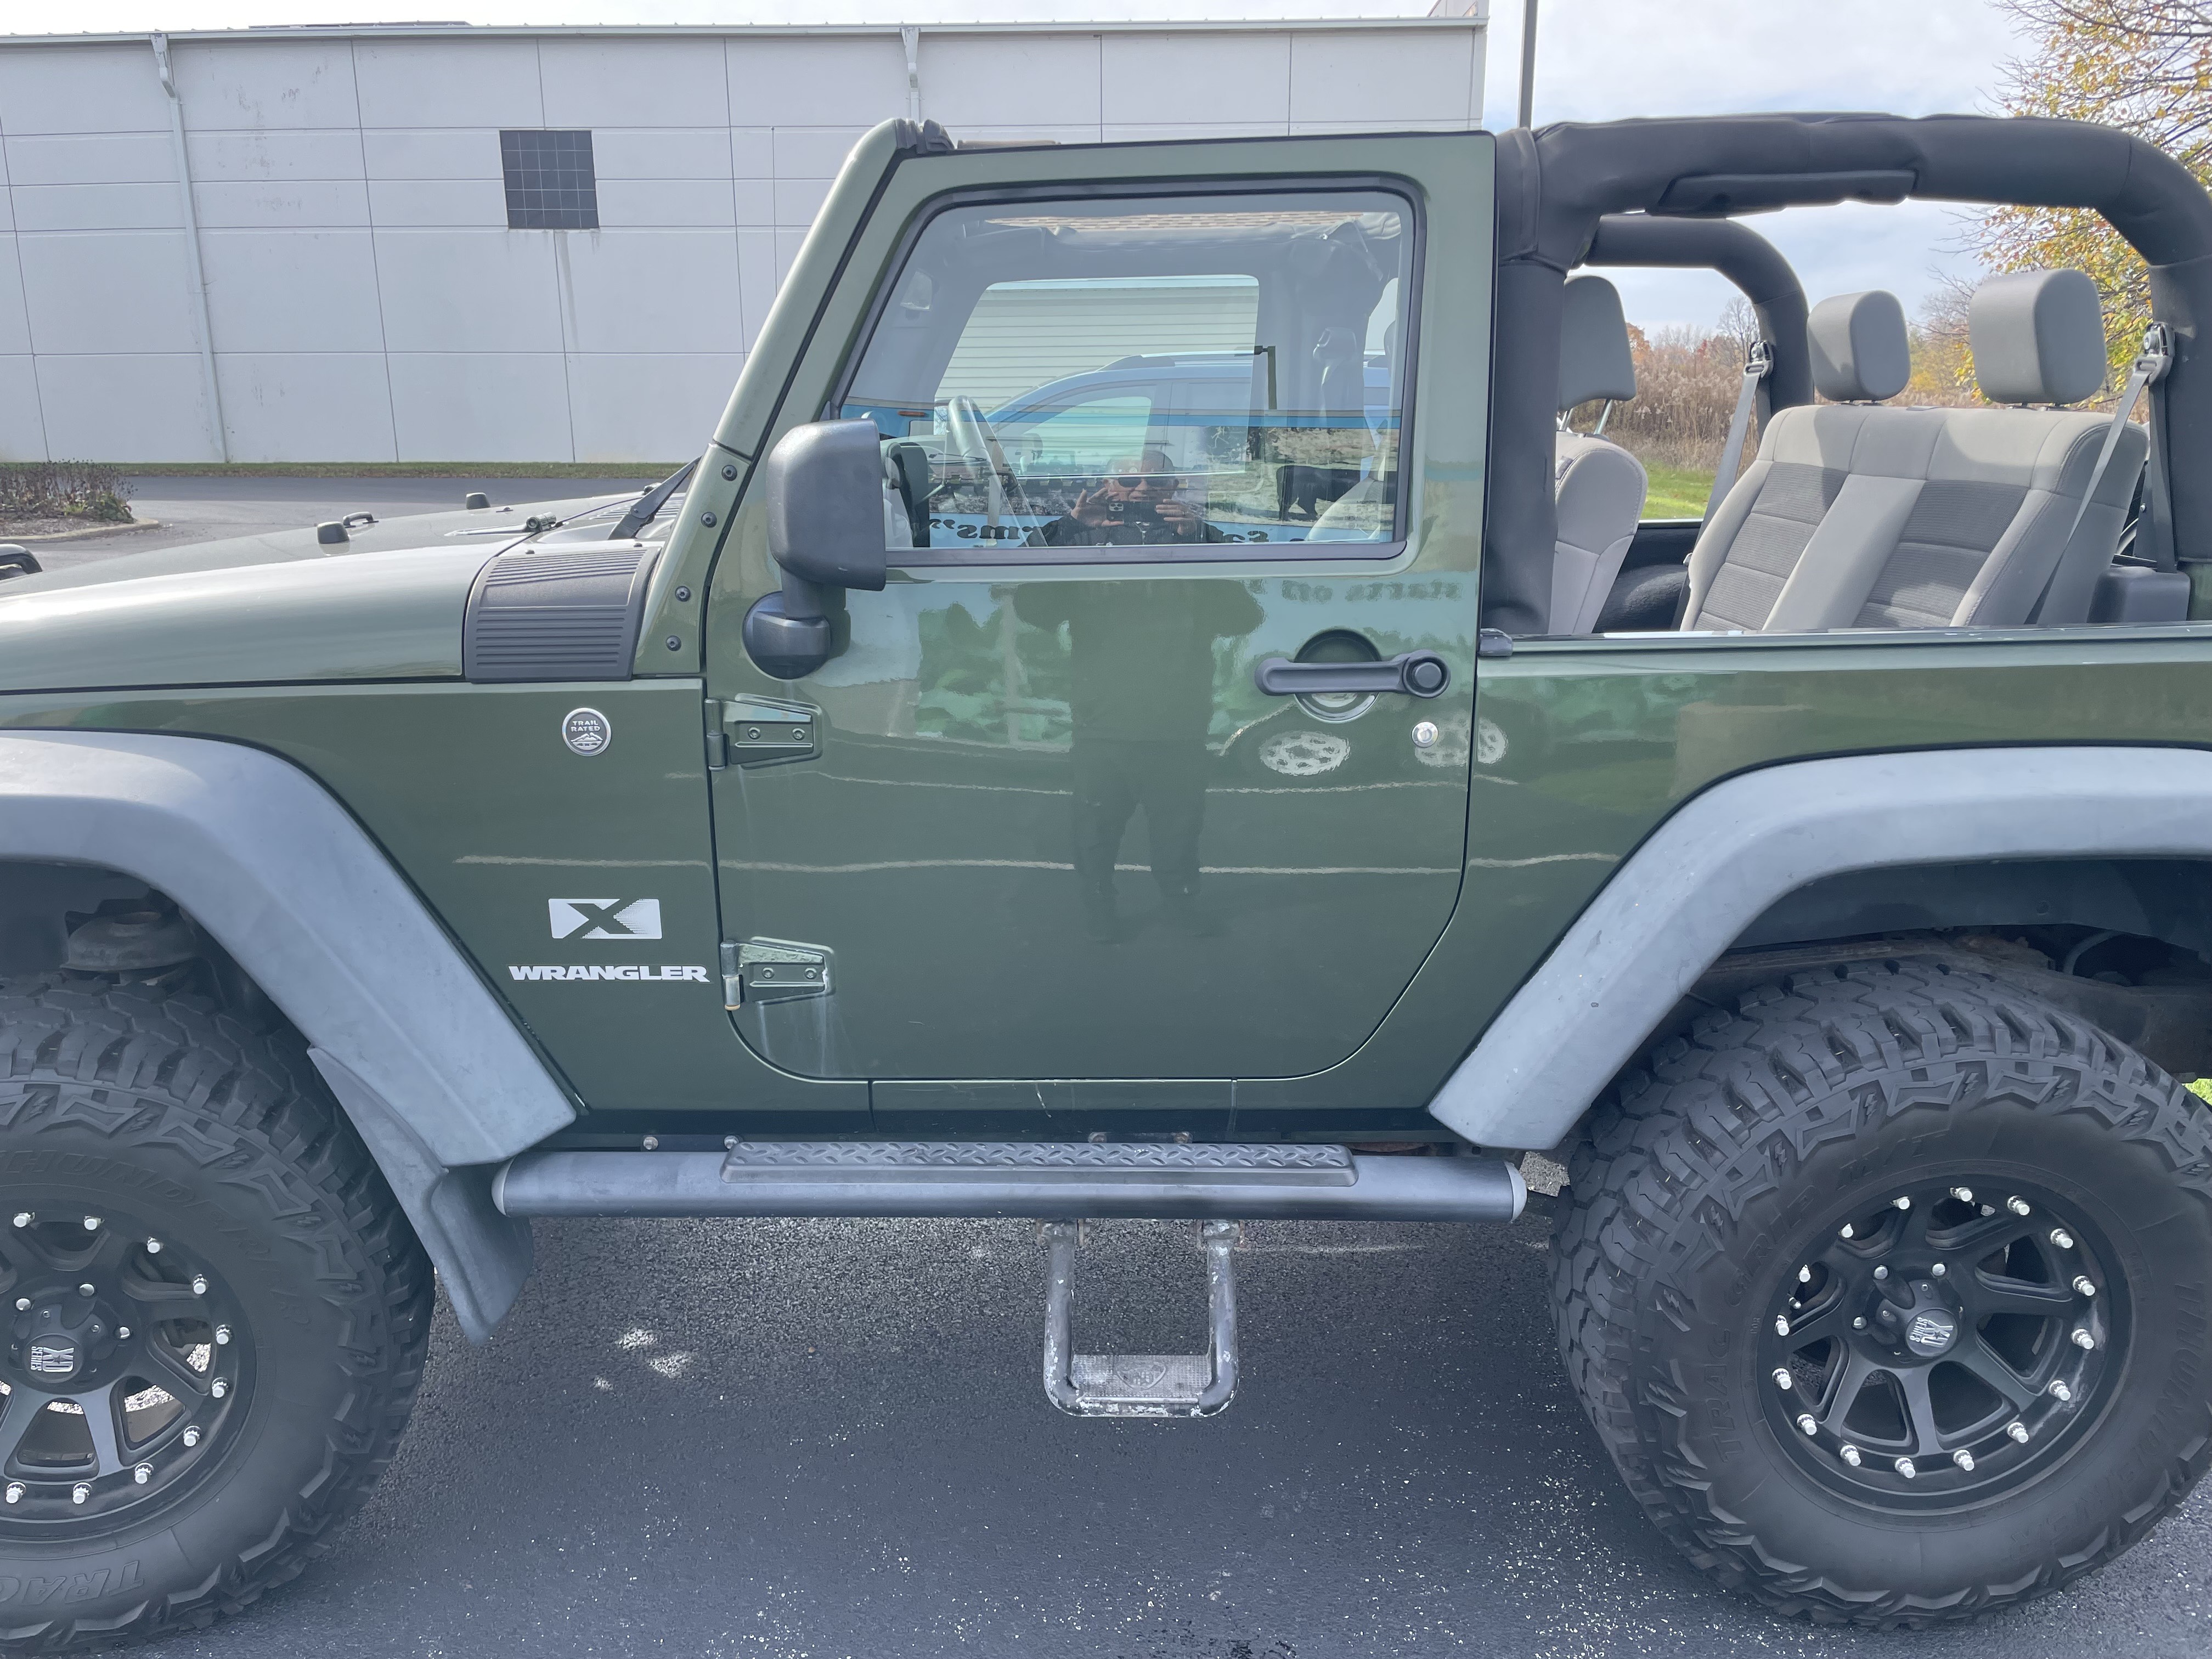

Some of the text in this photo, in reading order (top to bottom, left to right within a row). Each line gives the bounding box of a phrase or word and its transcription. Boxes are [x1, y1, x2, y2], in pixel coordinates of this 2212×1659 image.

[508, 965, 711, 983] WRANGLER
[0, 1150, 311, 1324] HUNDERER
[1909, 1317, 1928, 1342] SERIES
[30, 1346, 43, 1371] SERIES
[1702, 1329, 1743, 1464] TRAC
